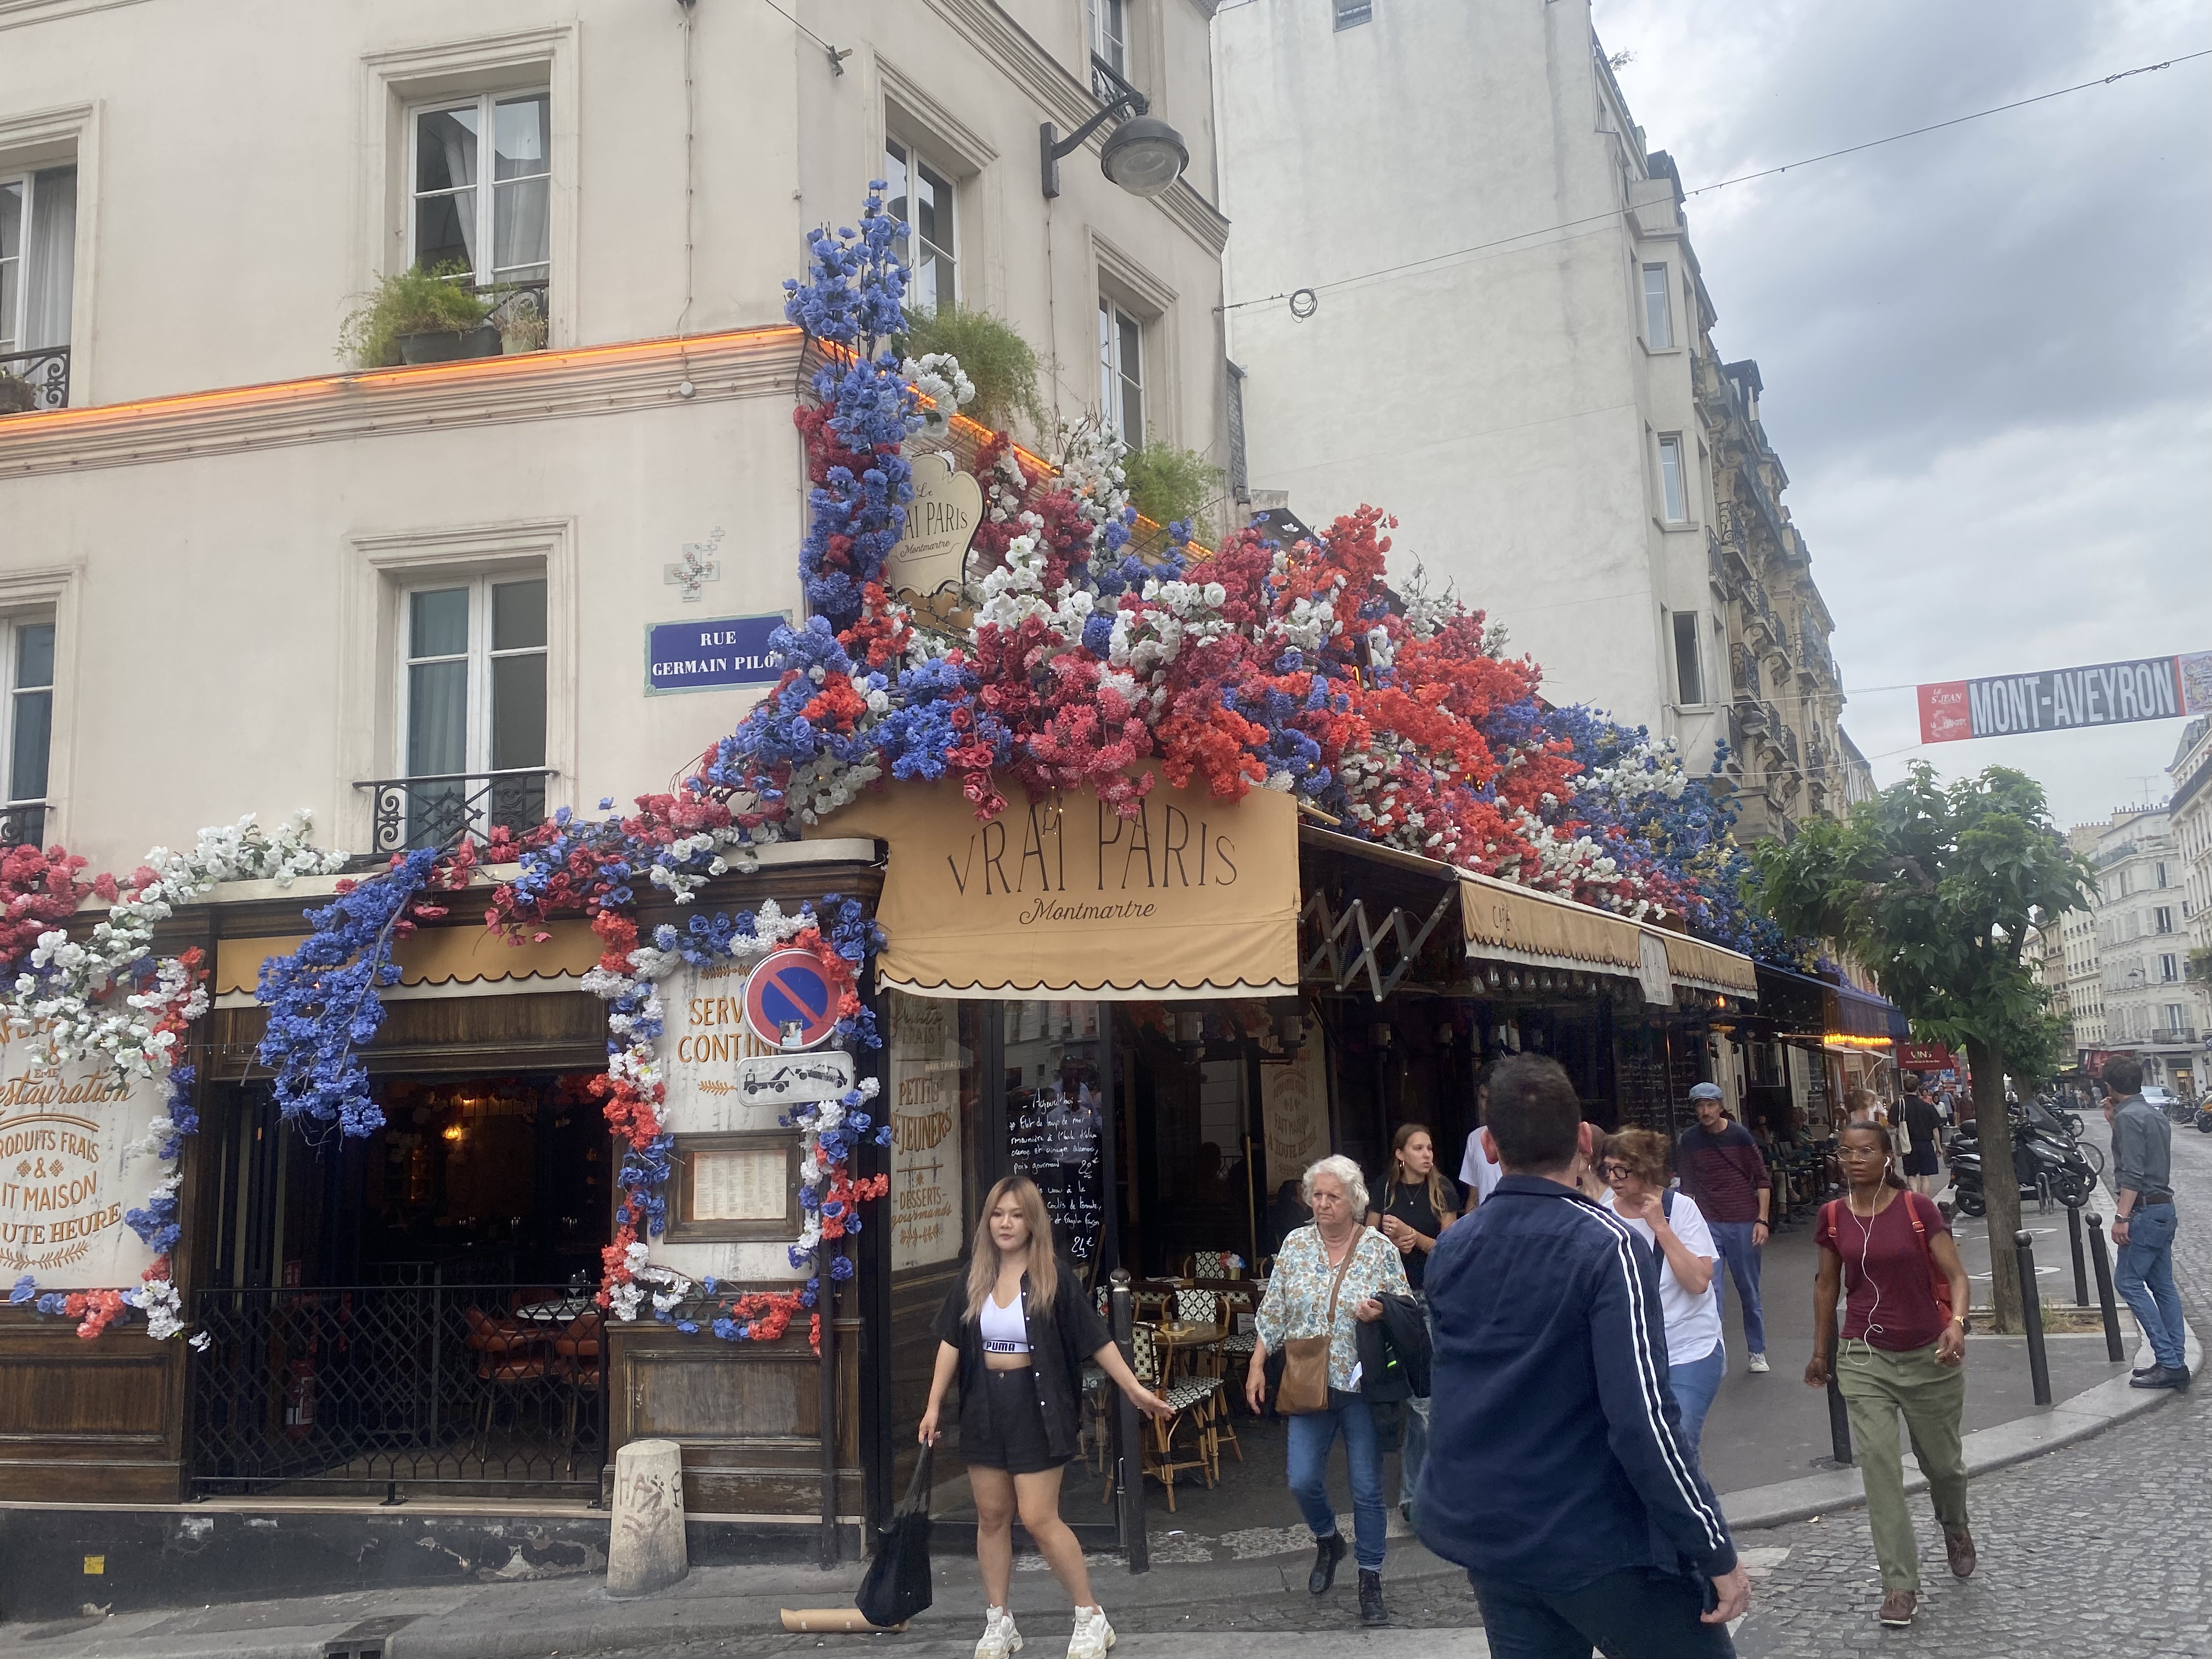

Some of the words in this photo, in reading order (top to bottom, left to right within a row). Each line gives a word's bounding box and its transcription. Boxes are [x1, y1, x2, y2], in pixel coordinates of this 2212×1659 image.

[916, 482, 933, 498] Le
[900, 505, 919, 540] AI
[927, 502, 968, 535] PARIS
[900, 540, 951, 557] Montmartre
[701, 631, 736, 646] RUE
[652, 658, 727, 676] GERMAIN
[735, 655, 778, 670] PILO
[1938, 692, 1962, 703] JEAN
[1970, 661, 2176, 735] MONT-AVEYRON
[947, 797, 1066, 896] VRAI
[1098, 798, 1238, 890] PARIS
[1019, 898, 1158, 926] Montmartre
[689, 996, 743, 1026] SERV
[678, 1033, 779, 1063] CONTIN
[898, 1077, 939, 1105] PETITS
[891, 1103, 952, 1155] ÉJEUNERS
[1073, 1116, 1085, 1125] mer
[60, 1131, 99, 1163] FRAIS
[34, 1156, 46, 1178] &
[0, 1182, 20, 1209] IT
[23, 1170, 97, 1212] MAISON
[0, 1222, 45, 1244] UTE
[49, 1201, 122, 1243] HEURE
[986, 1341, 1015, 1351] PUMA
